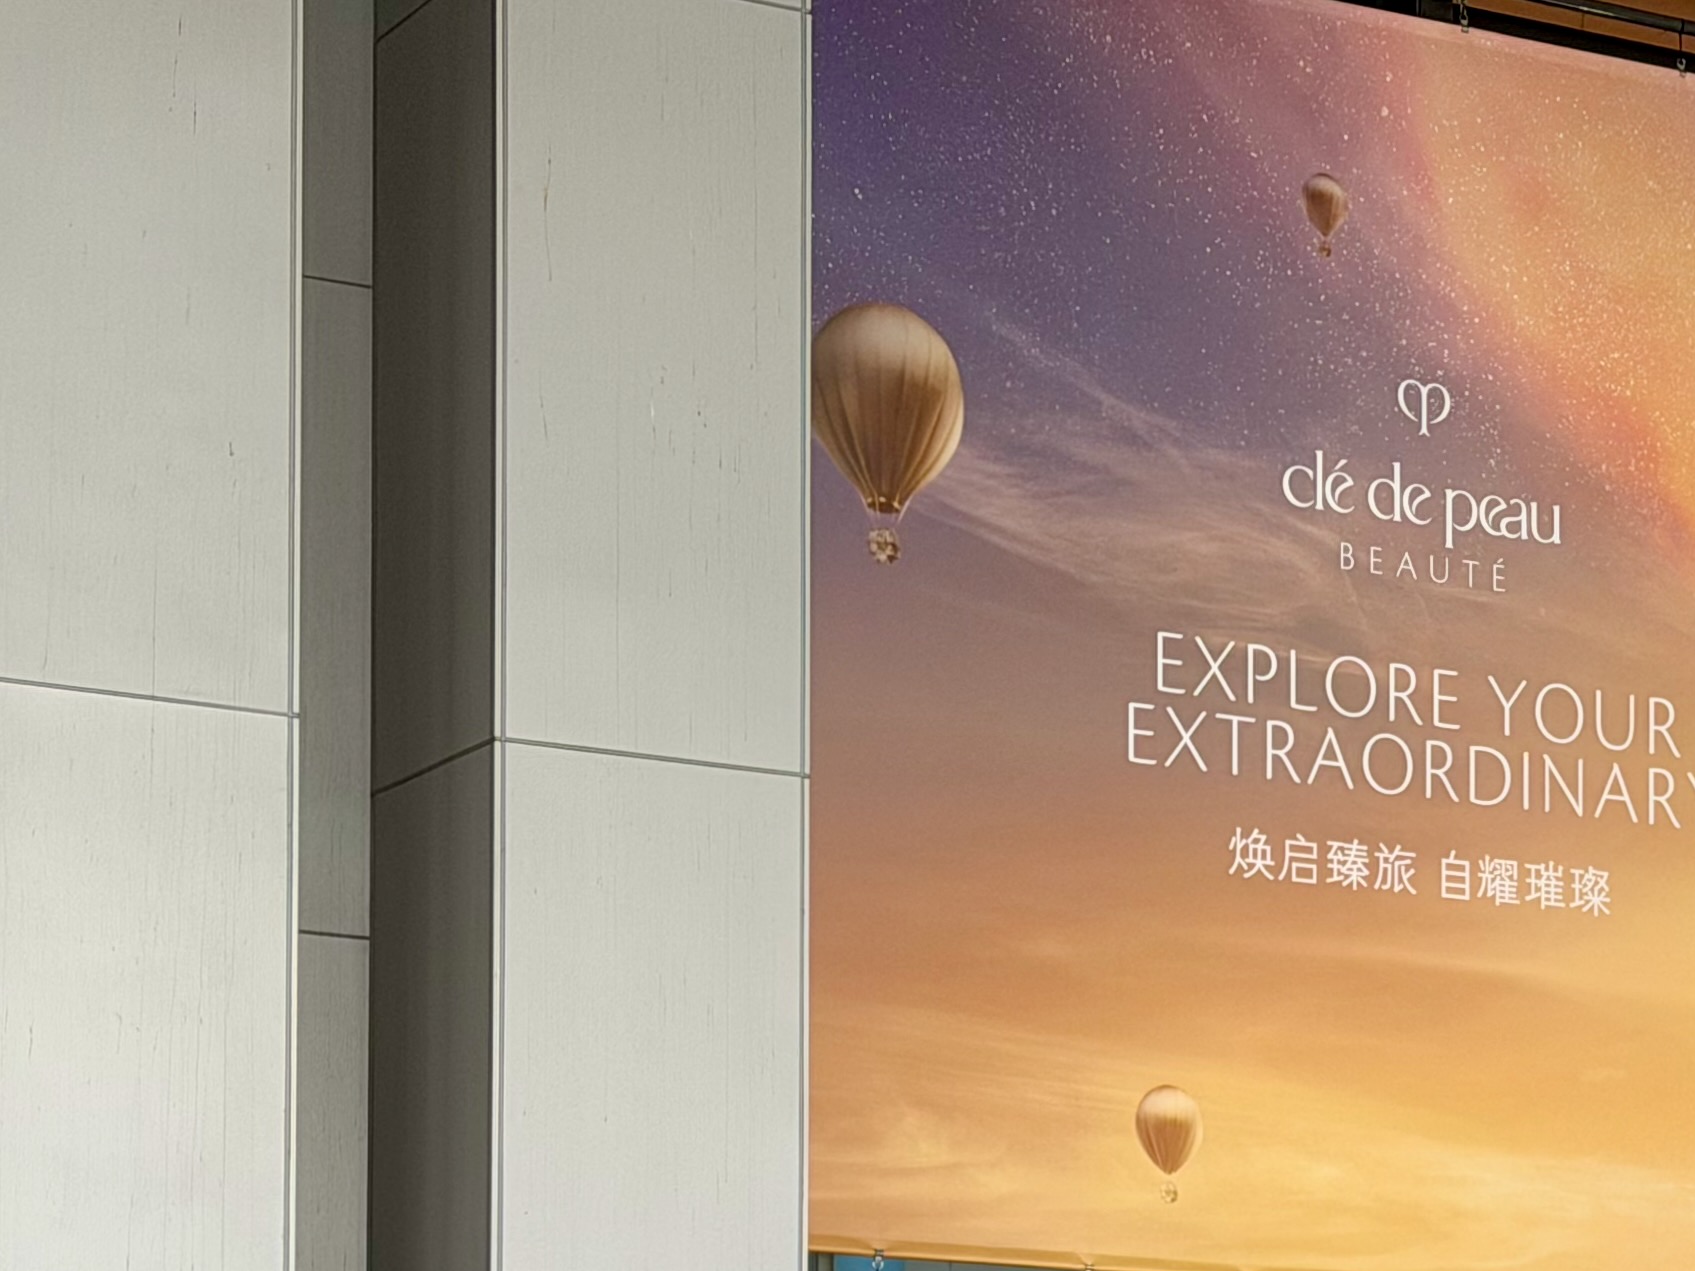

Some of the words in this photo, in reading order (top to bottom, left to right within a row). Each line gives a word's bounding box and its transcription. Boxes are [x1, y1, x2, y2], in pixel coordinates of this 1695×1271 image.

[1282, 449, 1355, 514] clé
[1367, 461, 1433, 525] de
[1444, 487, 1561, 549] peau
[1339, 540, 1507, 592] BEAUTÉ
[1155, 631, 1461, 730] EXPLORE
[1487, 674, 1681, 758] YOUR
[1228, 826, 1417, 895] 焕启臻旅
[1439, 849, 1612, 917] 自耀璀璨
